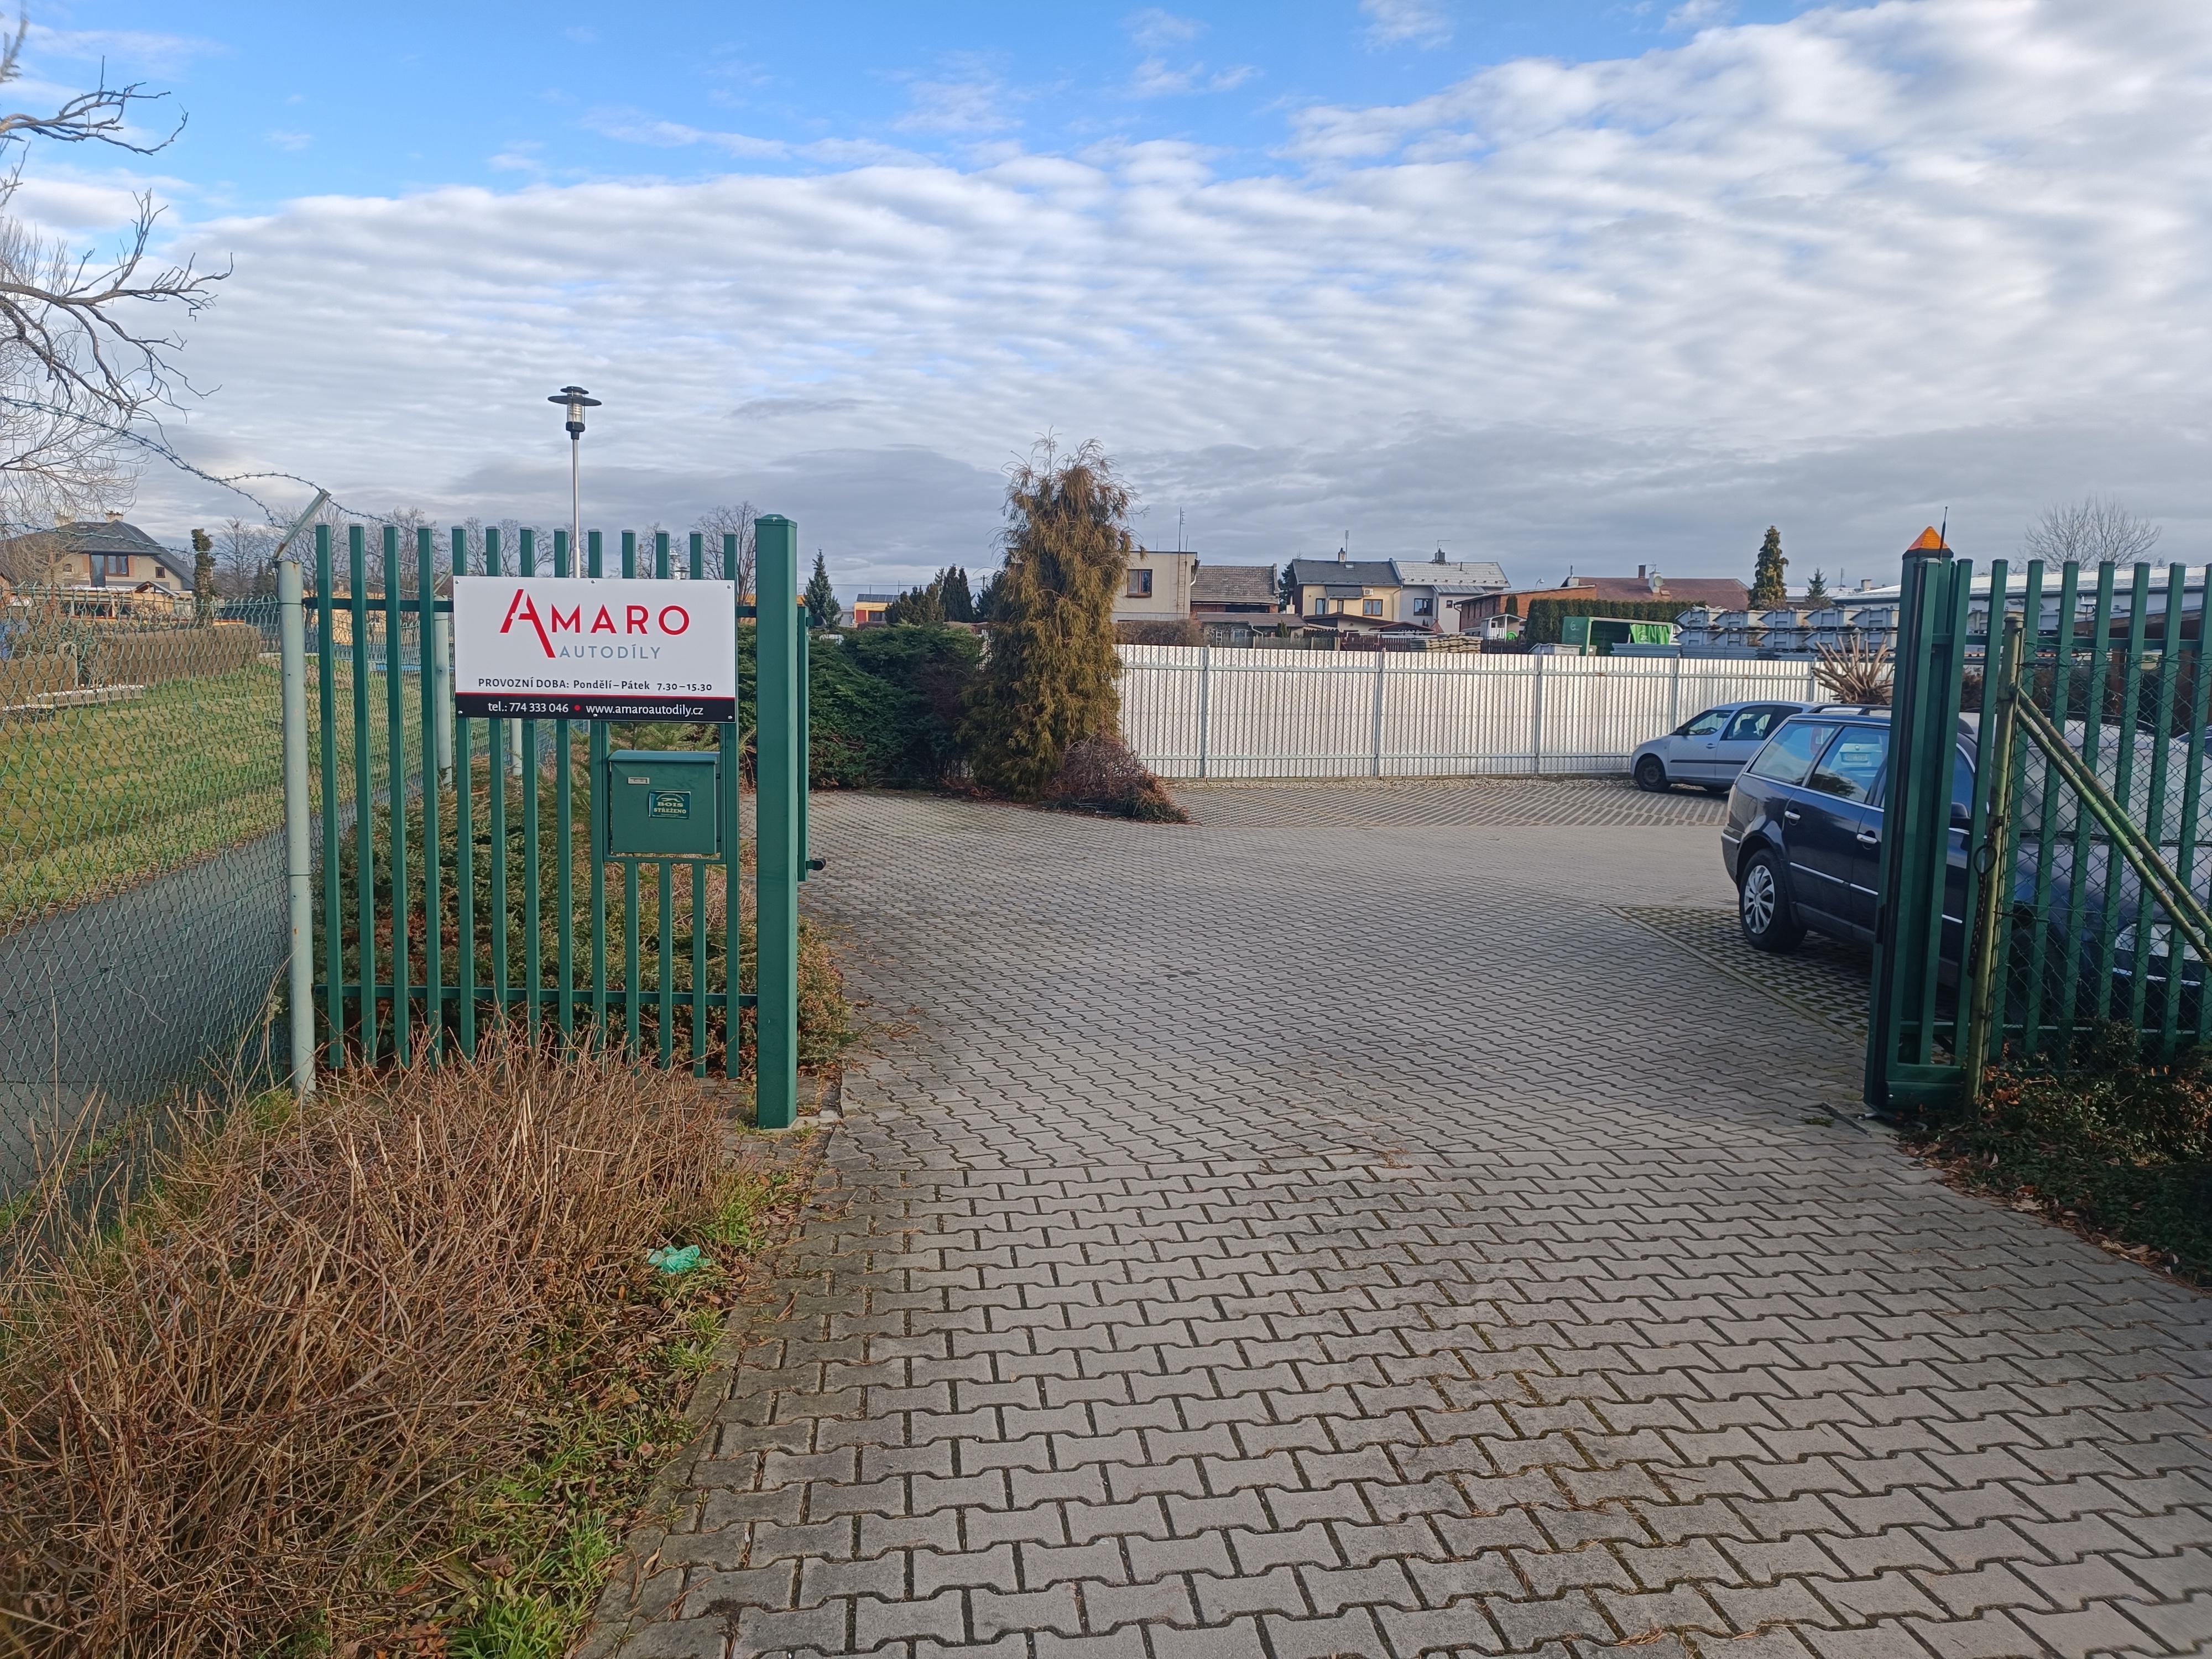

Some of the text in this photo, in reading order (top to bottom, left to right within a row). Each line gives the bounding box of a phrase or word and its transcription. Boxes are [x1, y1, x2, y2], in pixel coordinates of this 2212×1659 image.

[500, 589, 690, 658] AMARO
[560, 644, 661, 659] AUTODÍLY
[478, 677, 534, 687] PROVOZNÍ
[536, 680, 569, 688] DOBA:
[488, 701, 703, 717] tel.: 774 333 046 www.amaroautodily.cz
